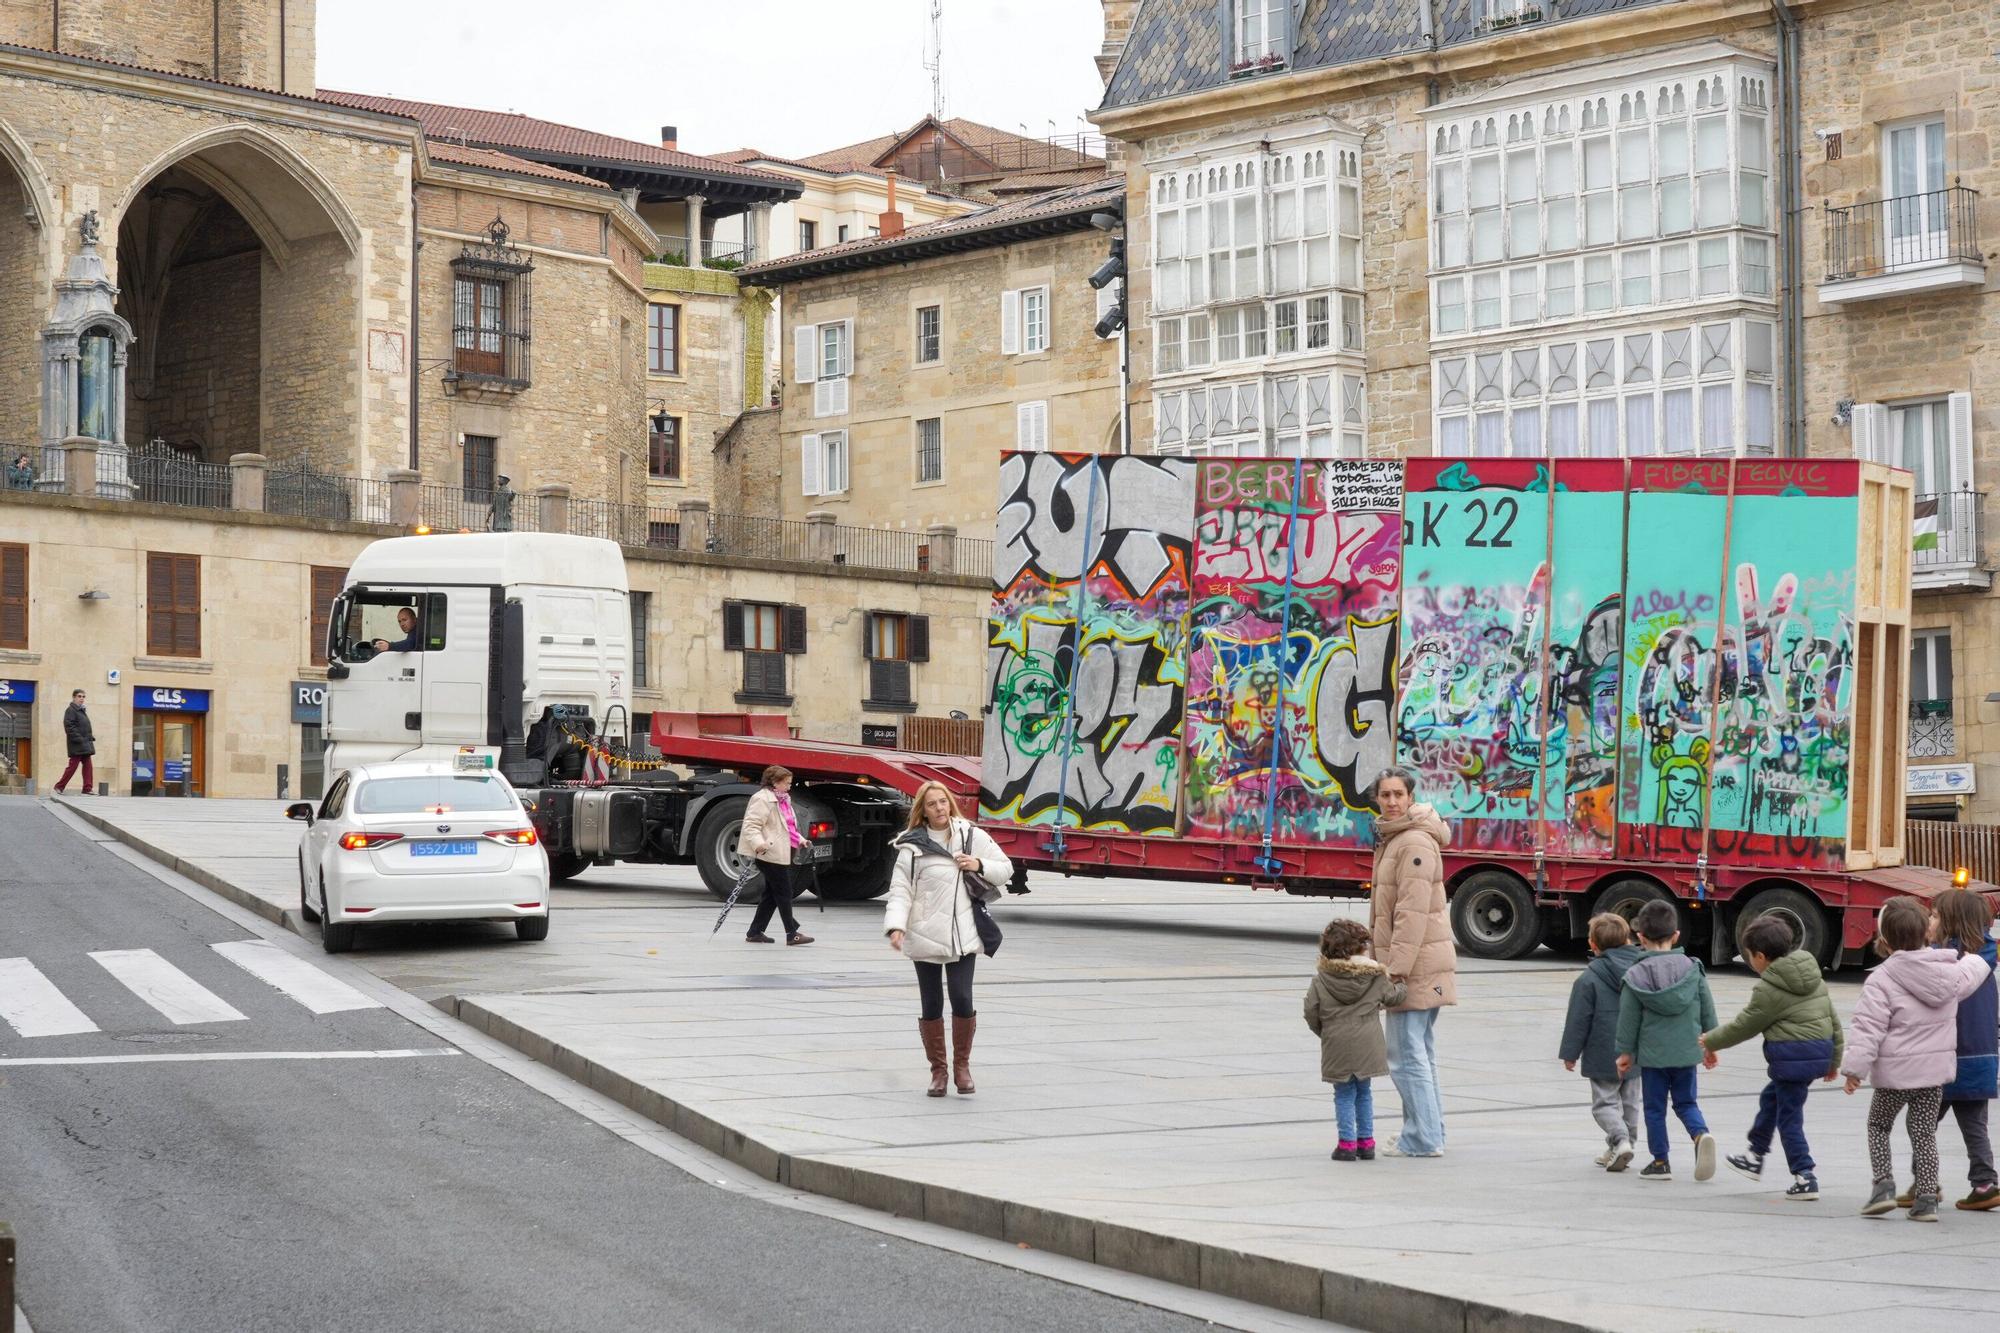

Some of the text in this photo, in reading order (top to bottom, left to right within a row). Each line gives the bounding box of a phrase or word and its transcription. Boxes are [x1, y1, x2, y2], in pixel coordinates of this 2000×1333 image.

[1388, 462, 1403, 472] PA
[1463, 496, 1519, 548] 22
[418, 842, 476, 855] 5527 LHH
